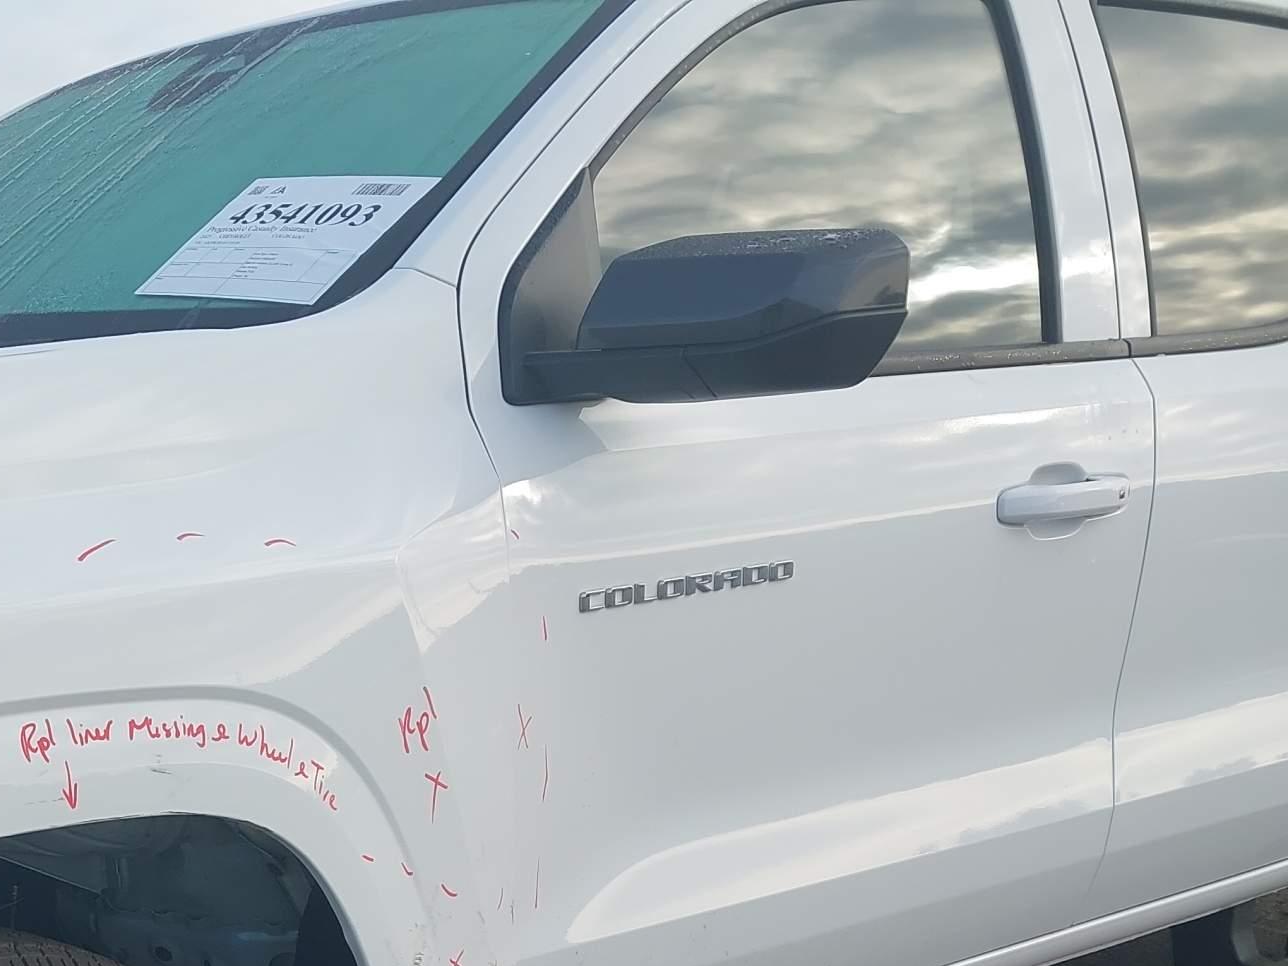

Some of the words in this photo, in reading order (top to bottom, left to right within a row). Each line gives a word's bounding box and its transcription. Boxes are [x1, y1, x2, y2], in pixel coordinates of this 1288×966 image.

[228, 202, 382, 227] 43541093
[578, 560, 794, 613] COLORADO
[66, 718, 113, 746] liner
[128, 714, 207, 748] Missing
[311, 759, 338, 811] Tire
